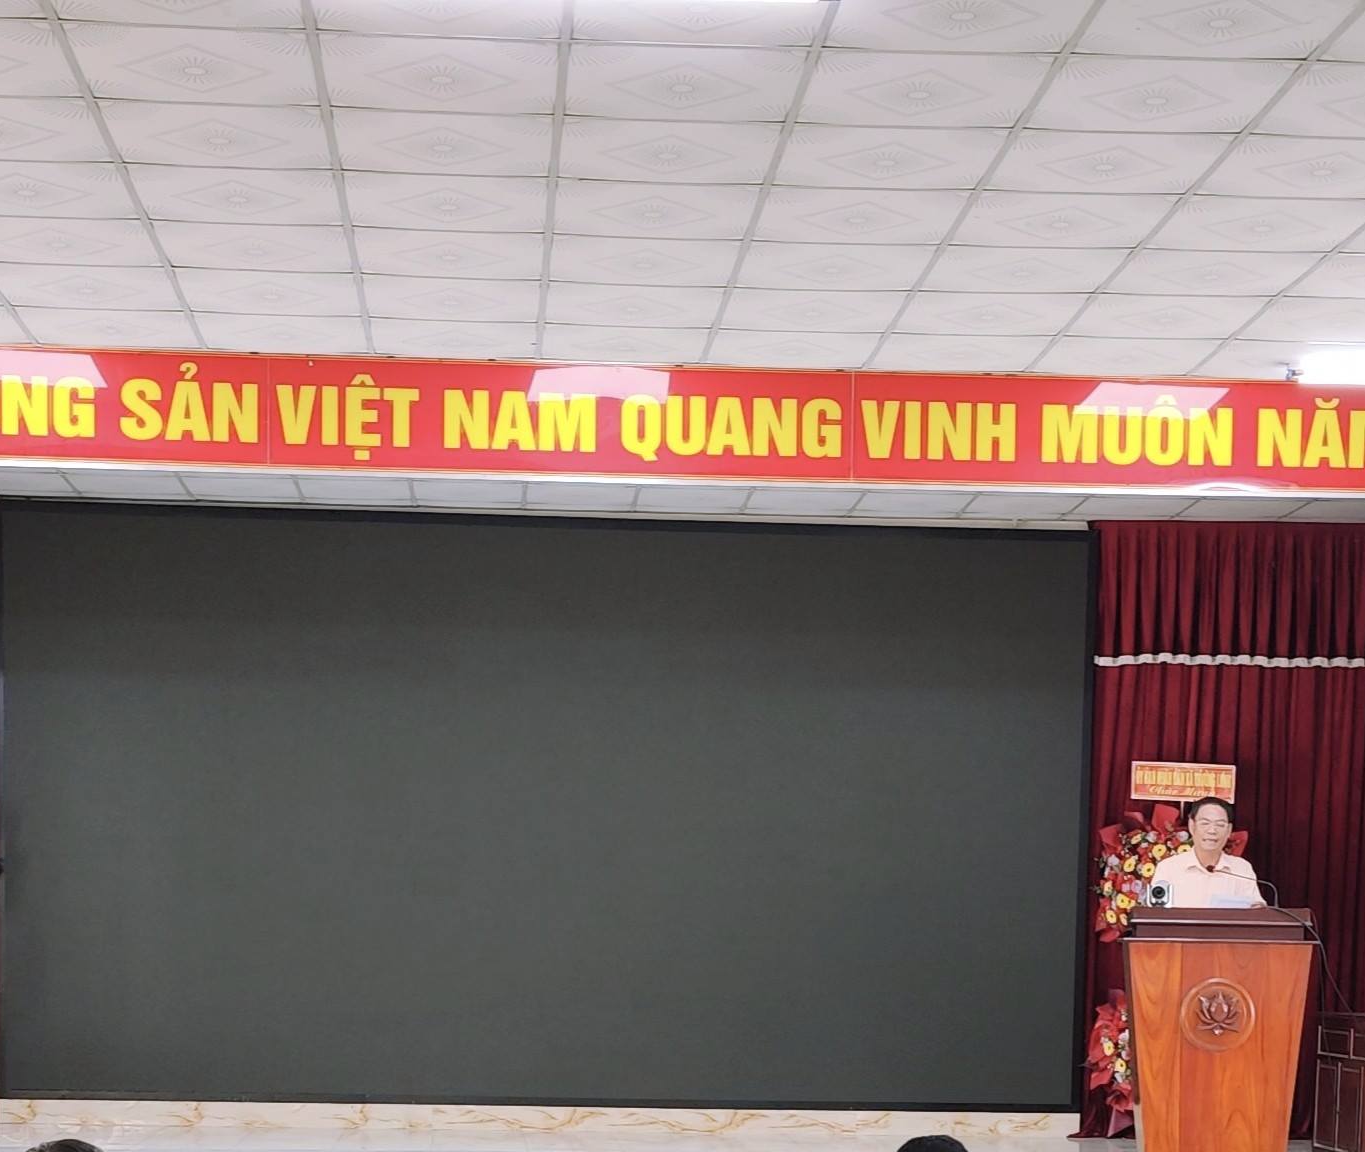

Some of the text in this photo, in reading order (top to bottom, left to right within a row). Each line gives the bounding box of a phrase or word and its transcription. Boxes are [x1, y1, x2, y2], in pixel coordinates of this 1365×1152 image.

[120, 362, 259, 443] SẢN
[276, 373, 420, 461] VIỆT
[443, 389, 597, 453] NAM
[620, 393, 843, 462] QUANG
[860, 399, 1017, 462] VINH
[1040, 395, 1234, 467] MUÔN
